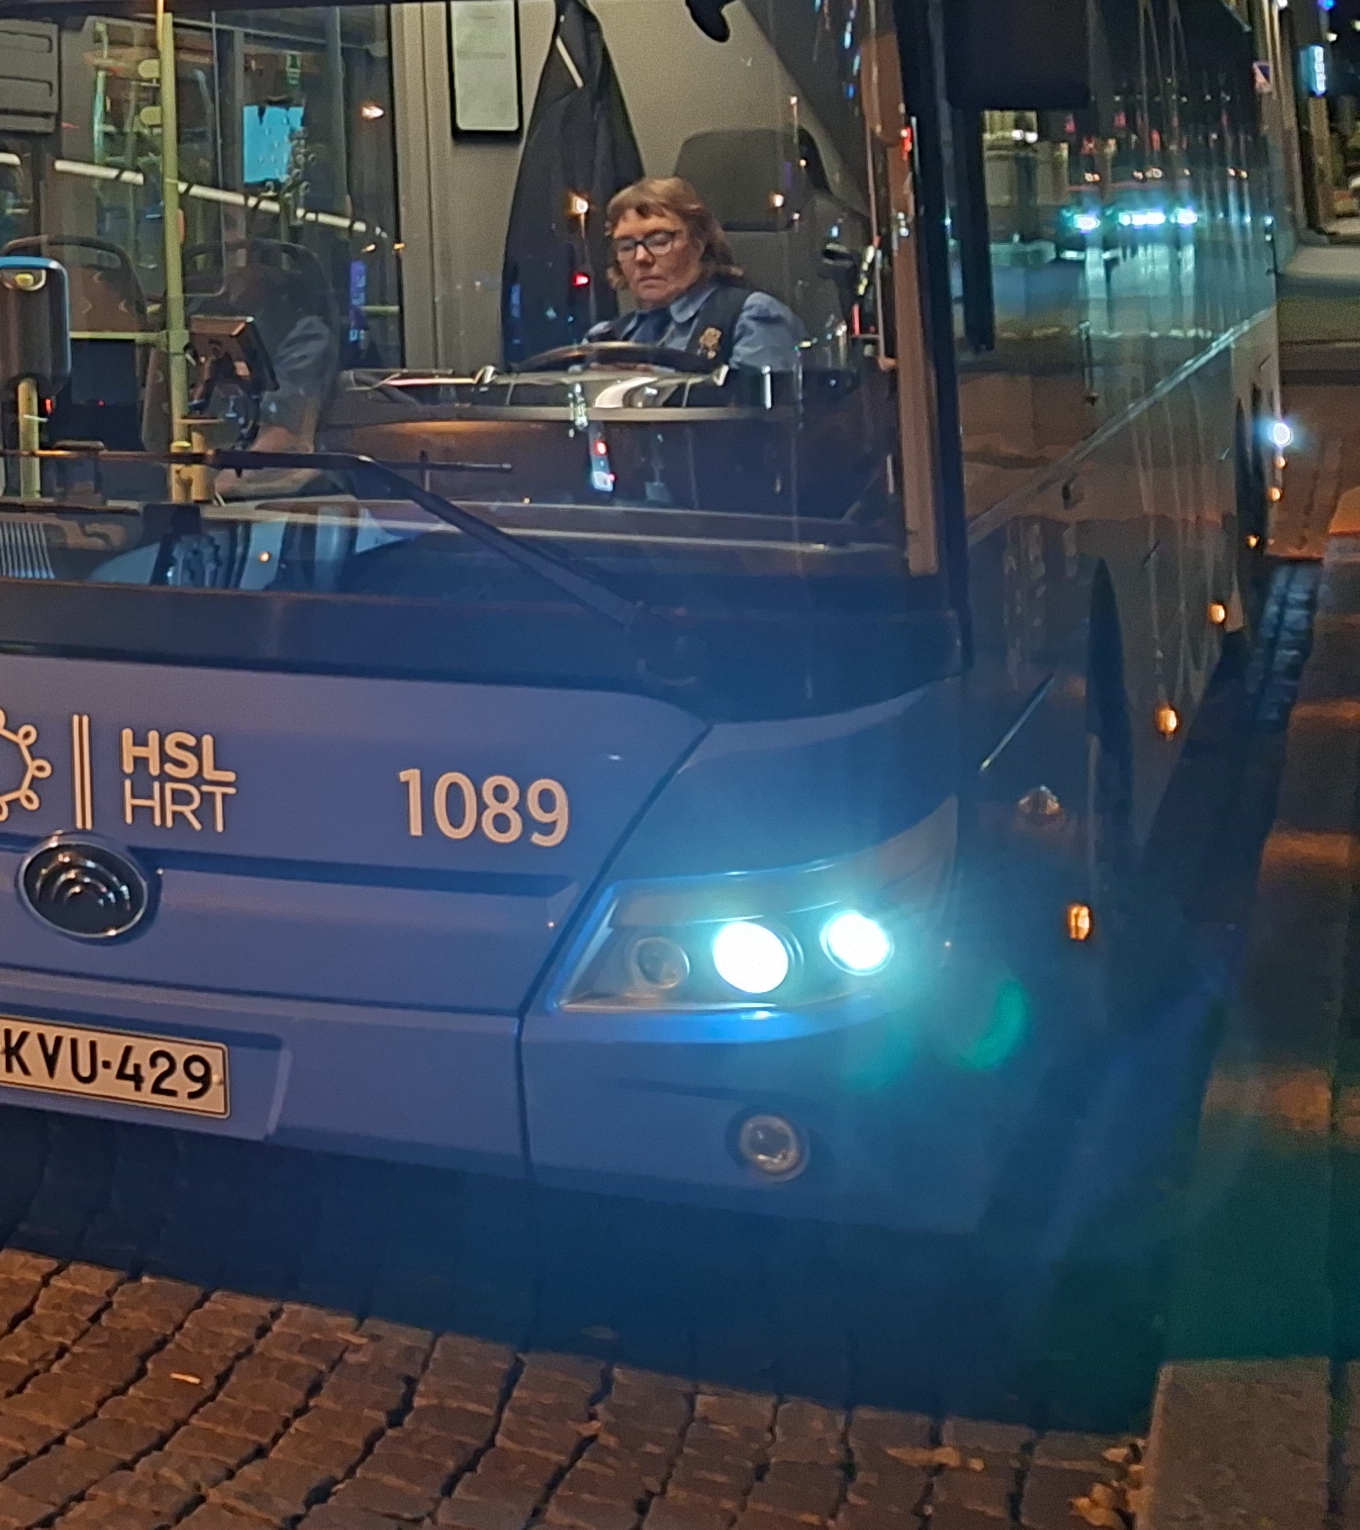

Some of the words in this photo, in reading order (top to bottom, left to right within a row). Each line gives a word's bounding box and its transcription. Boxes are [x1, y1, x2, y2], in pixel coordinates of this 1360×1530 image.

[121, 728, 237, 783] HSL
[123, 780, 237, 833] HRT
[399, 767, 570, 847] 1089
[3, 1028, 212, 1100] KVU-429
